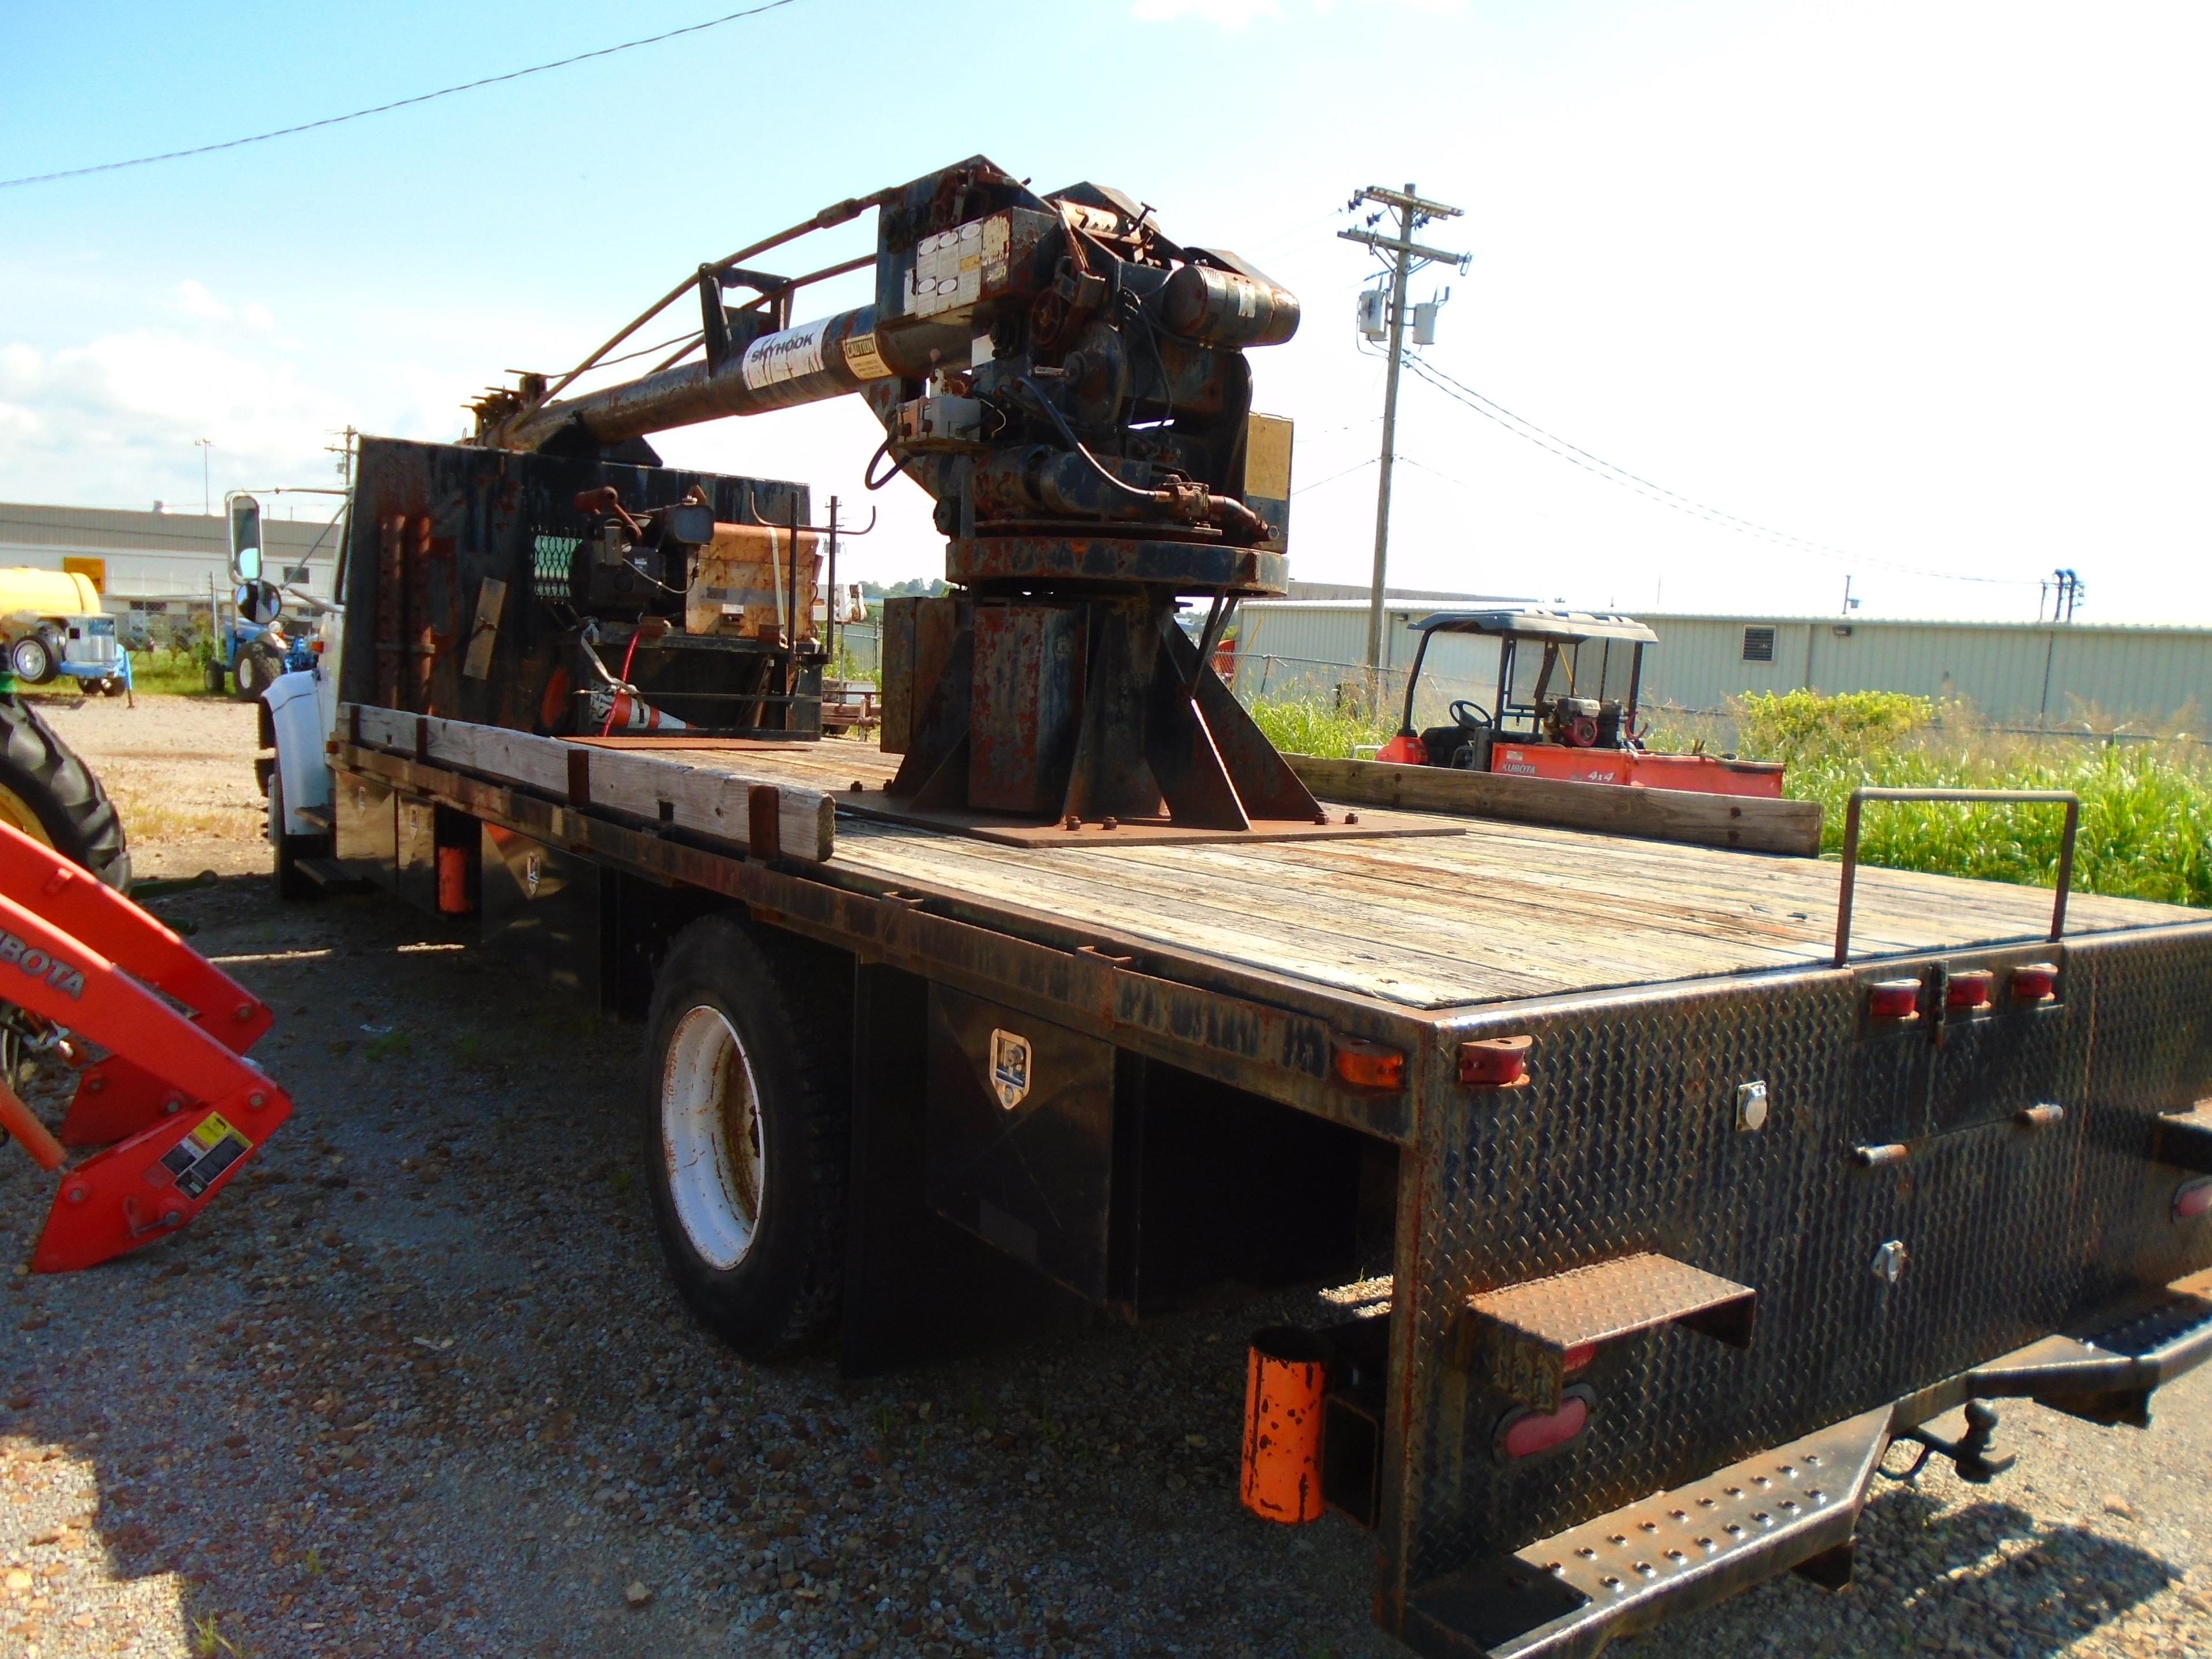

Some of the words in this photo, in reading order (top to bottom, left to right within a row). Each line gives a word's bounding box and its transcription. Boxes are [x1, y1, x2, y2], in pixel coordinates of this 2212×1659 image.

[751, 333, 815, 362] SKYHOOK
[847, 340, 874, 357] CAUTION
[1502, 763, 1536, 775] KUBOTA
[1588, 771, 1615, 781] 4x4
[0, 929, 85, 999] BOTA
